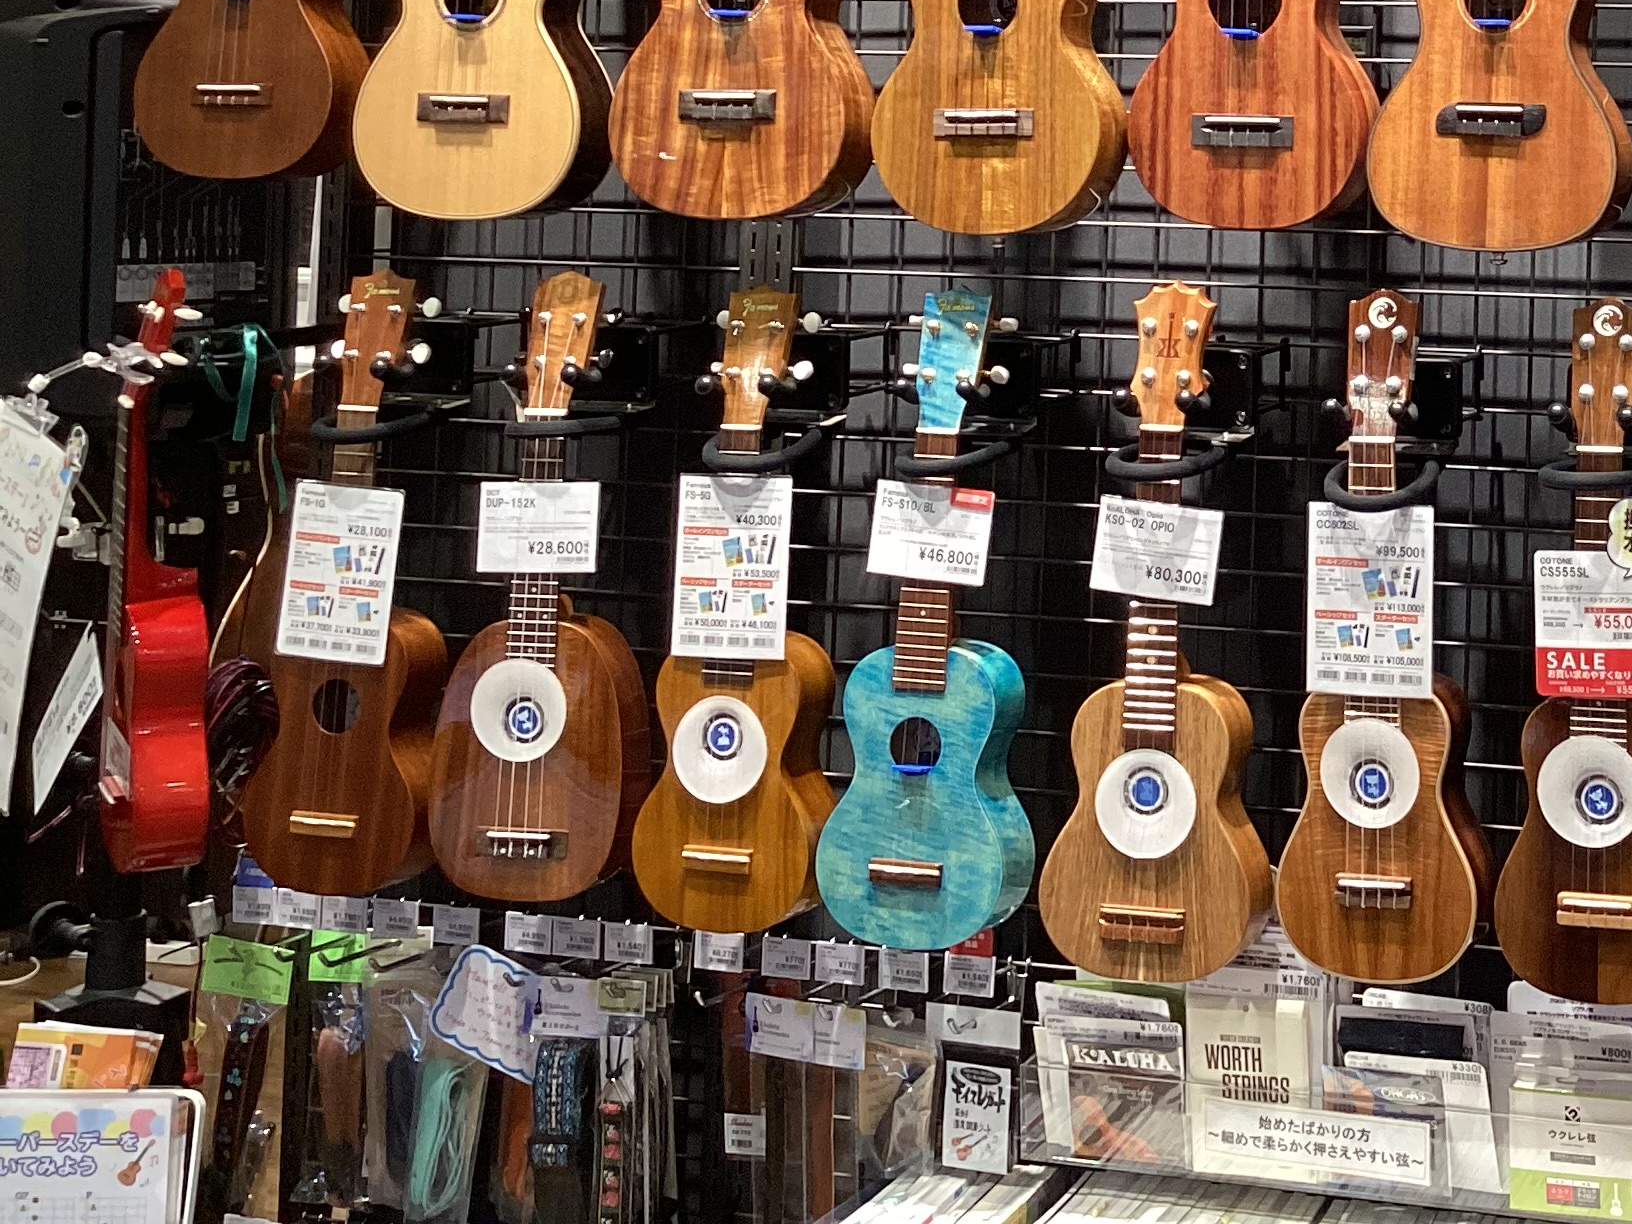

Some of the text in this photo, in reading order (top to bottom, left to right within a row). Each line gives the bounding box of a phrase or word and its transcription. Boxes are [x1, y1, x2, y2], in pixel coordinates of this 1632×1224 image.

[735, 514, 777, 527] ¥40,300
[528, 541, 583, 555] ¥28,600
[919, 546, 974, 566] ¥46,800
[1540, 557, 1573, 565] COTONE
[1146, 564, 1202, 585] ¥80,300
[1540, 566, 1590, 578] CS555SL
[1546, 651, 1606, 670] SALE
[1282, 973, 1317, 986] ¥1,760
[1464, 1002, 1489, 1015] ¥308
[1139, 1022, 1174, 1034] ¥1,760
[1204, 1043, 1263, 1073] WORTH
[1601, 1046, 1629, 1059] ¥800
[1452, 1062, 1478, 1073] ¥330
[1222, 1073, 1291, 1104] STRINGS
[1258, 1115, 1372, 1144] 始めたばかりの方
[1548, 1129, 1597, 1144] ウクレレ弦
